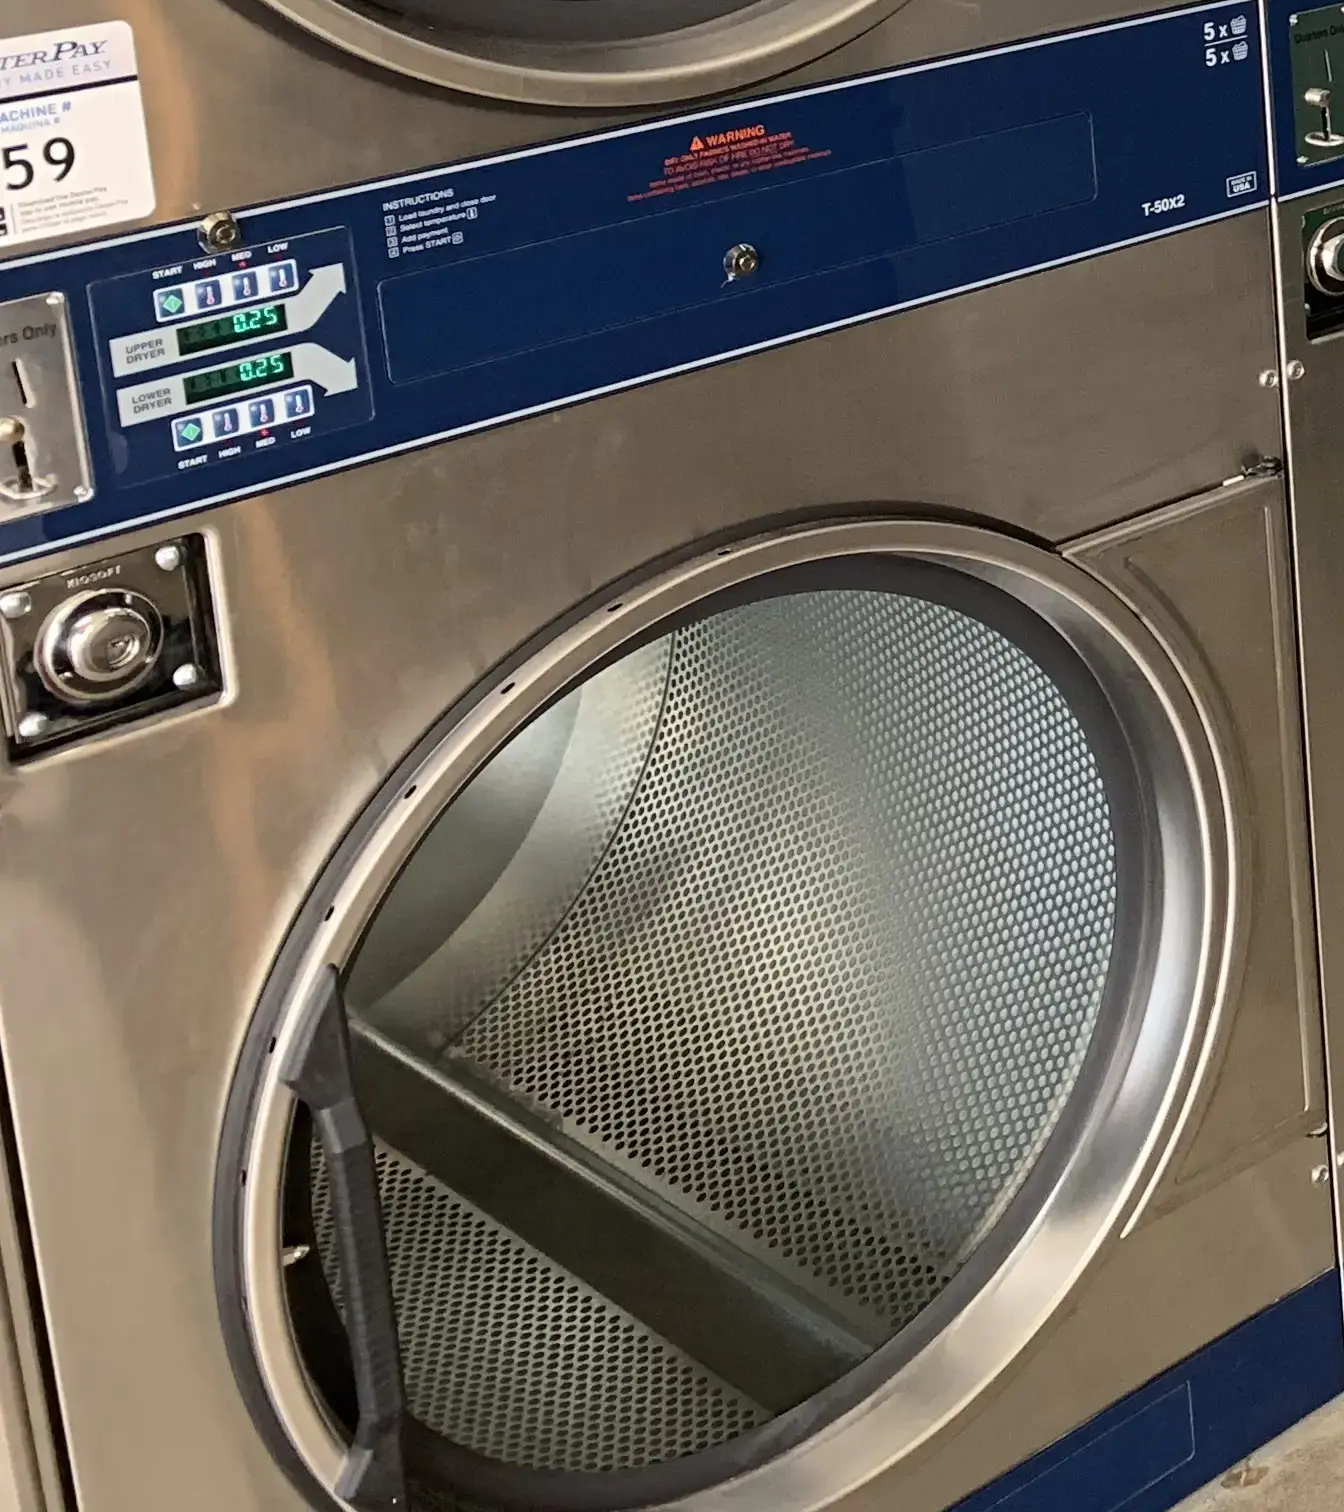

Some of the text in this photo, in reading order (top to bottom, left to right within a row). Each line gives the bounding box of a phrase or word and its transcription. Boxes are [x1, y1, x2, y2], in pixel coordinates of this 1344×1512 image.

[1204, 22, 1228, 41] 5 x
[1205, 48, 1230, 67] 5 x
[20, 59, 111, 85] MADE EASY
[62, 101, 72, 112] #
[706, 124, 765, 147] WARNING
[2, 136, 76, 190] 59
[1233, 181, 1250, 192] USA
[382, 188, 454, 211] INSTRUCTIONS
[1142, 194, 1185, 216] T-50X2
[400, 221, 423, 232] Select
[401, 234, 417, 243] Add
[425, 236, 451, 248] START
[152, 242, 288, 279] START HIGH MED LOW
[233, 306, 278, 333] 0.25
[22, 323, 56, 340] Only
[125, 338, 163, 354] UPPER
[126, 347, 165, 365] DRYER
[239, 354, 284, 381] 0.25
[132, 388, 171, 404] LOWER
[133, 397, 172, 414] DRYER
[178, 426, 311, 470] START HIGH MED LOW
